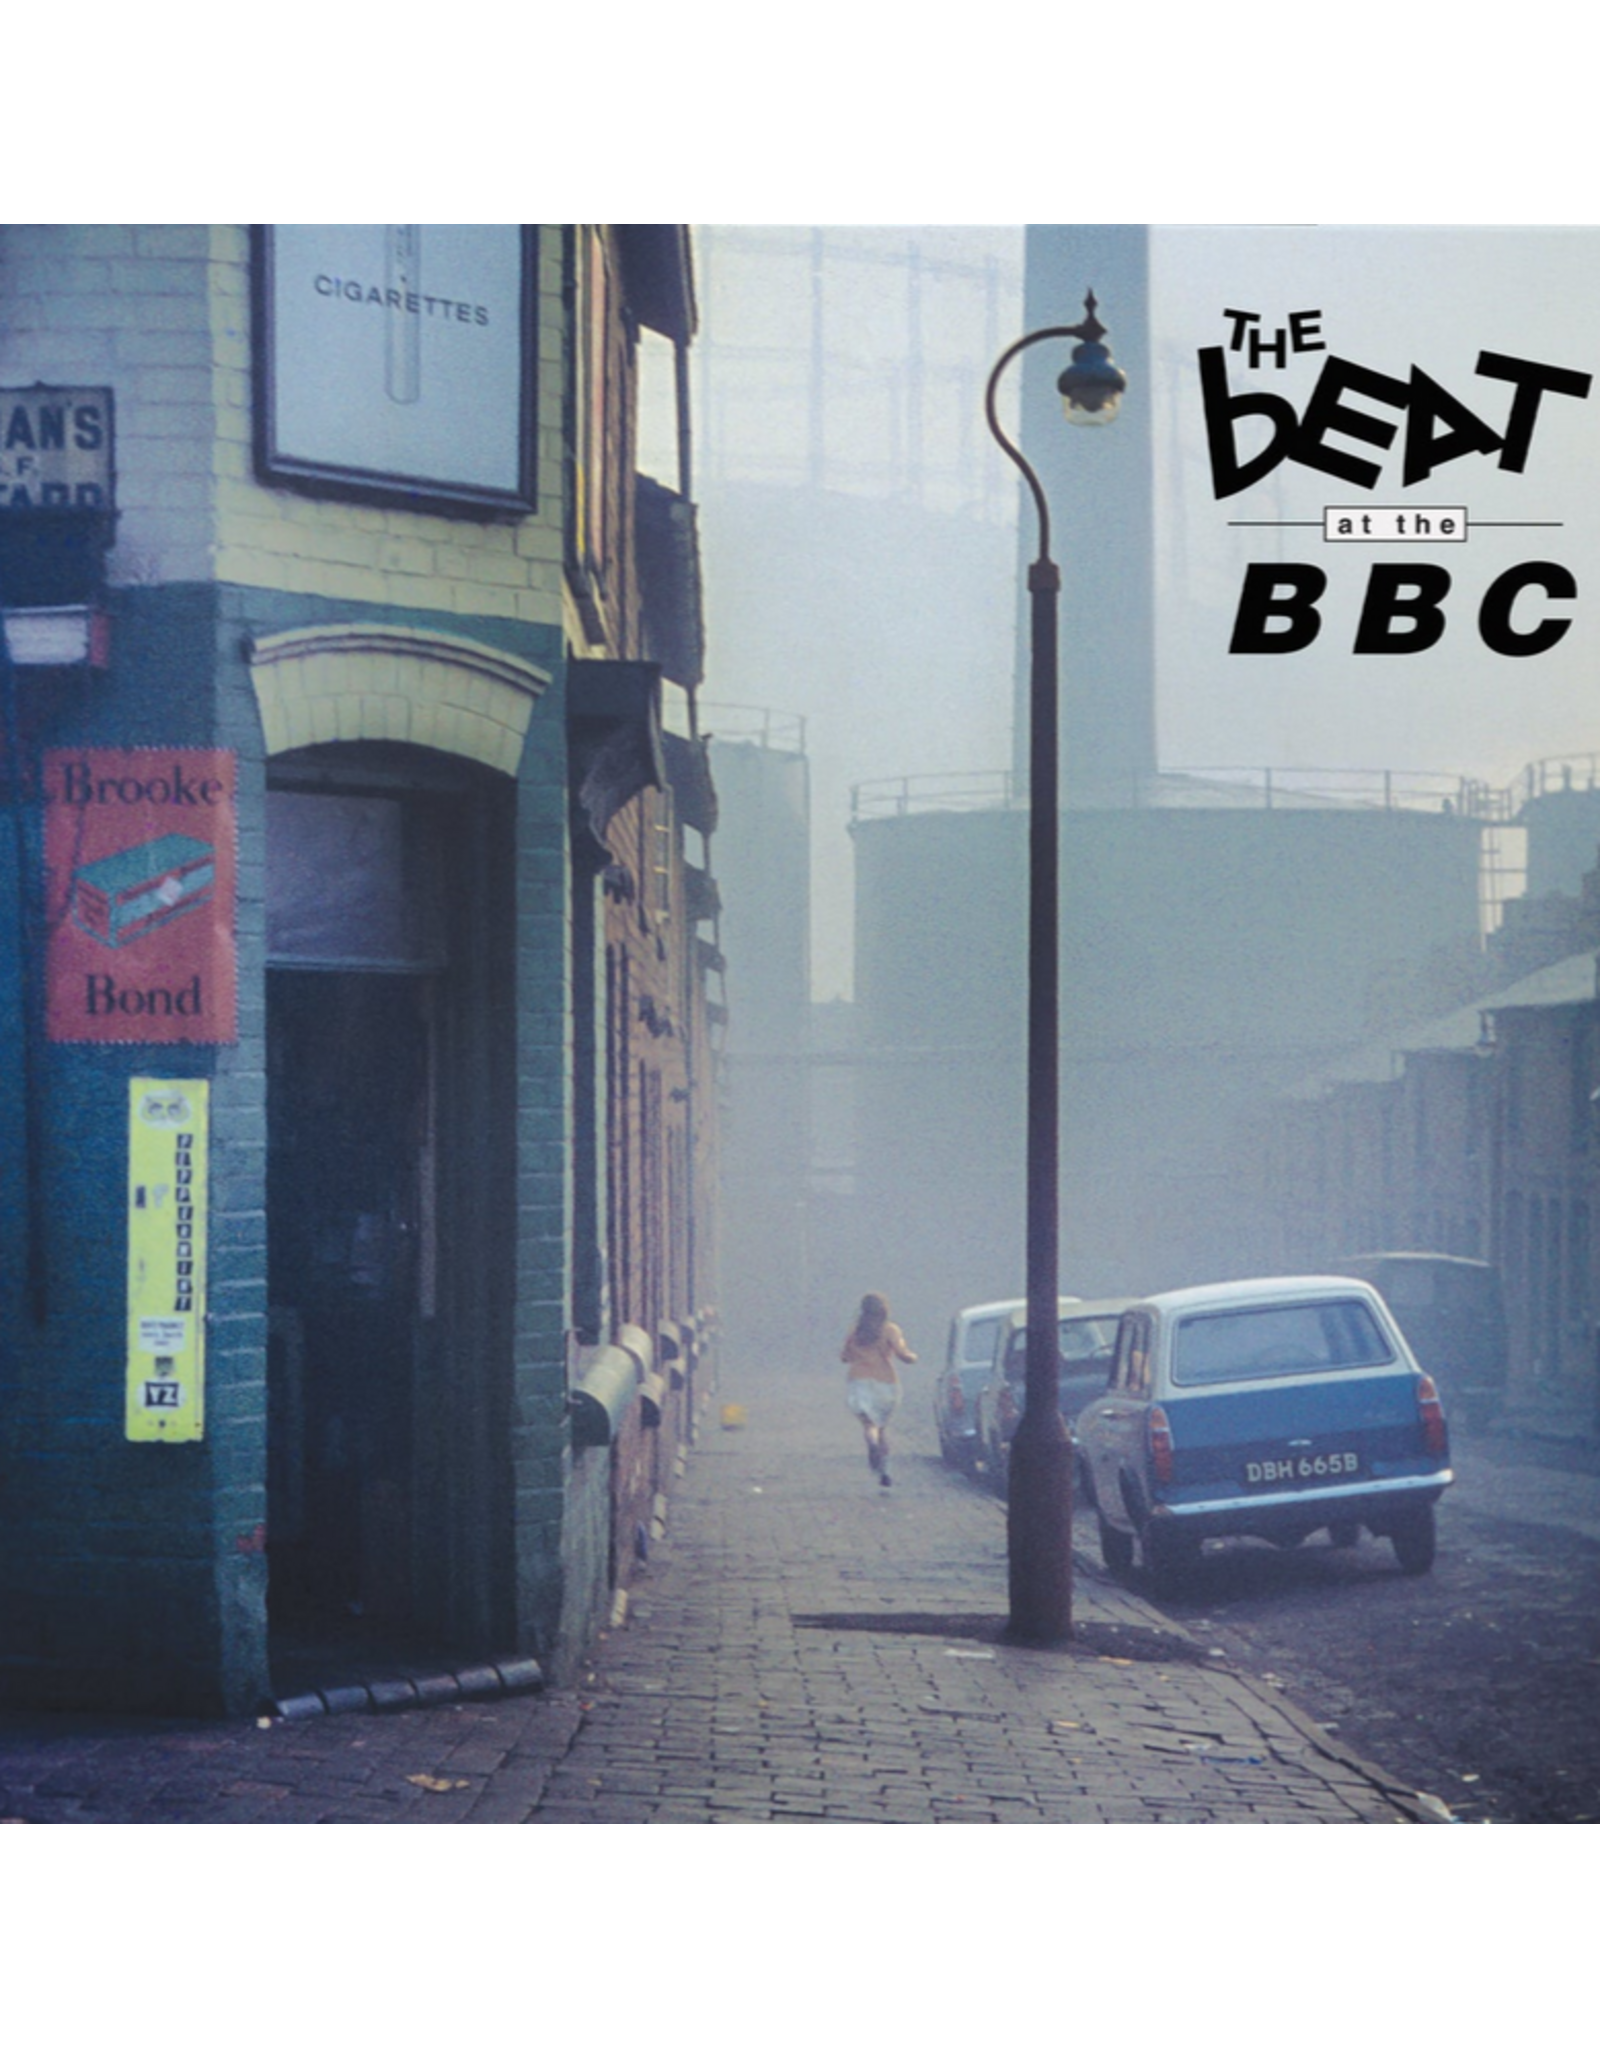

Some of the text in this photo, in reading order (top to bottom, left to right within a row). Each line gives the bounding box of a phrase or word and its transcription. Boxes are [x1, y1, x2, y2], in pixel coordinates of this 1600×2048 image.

[314, 274, 489, 327] CIGARETTES
[62, 762, 223, 805] Brooke
[86, 974, 201, 1016] Bond
[1246, 1453, 1359, 1482] DBH 665B
